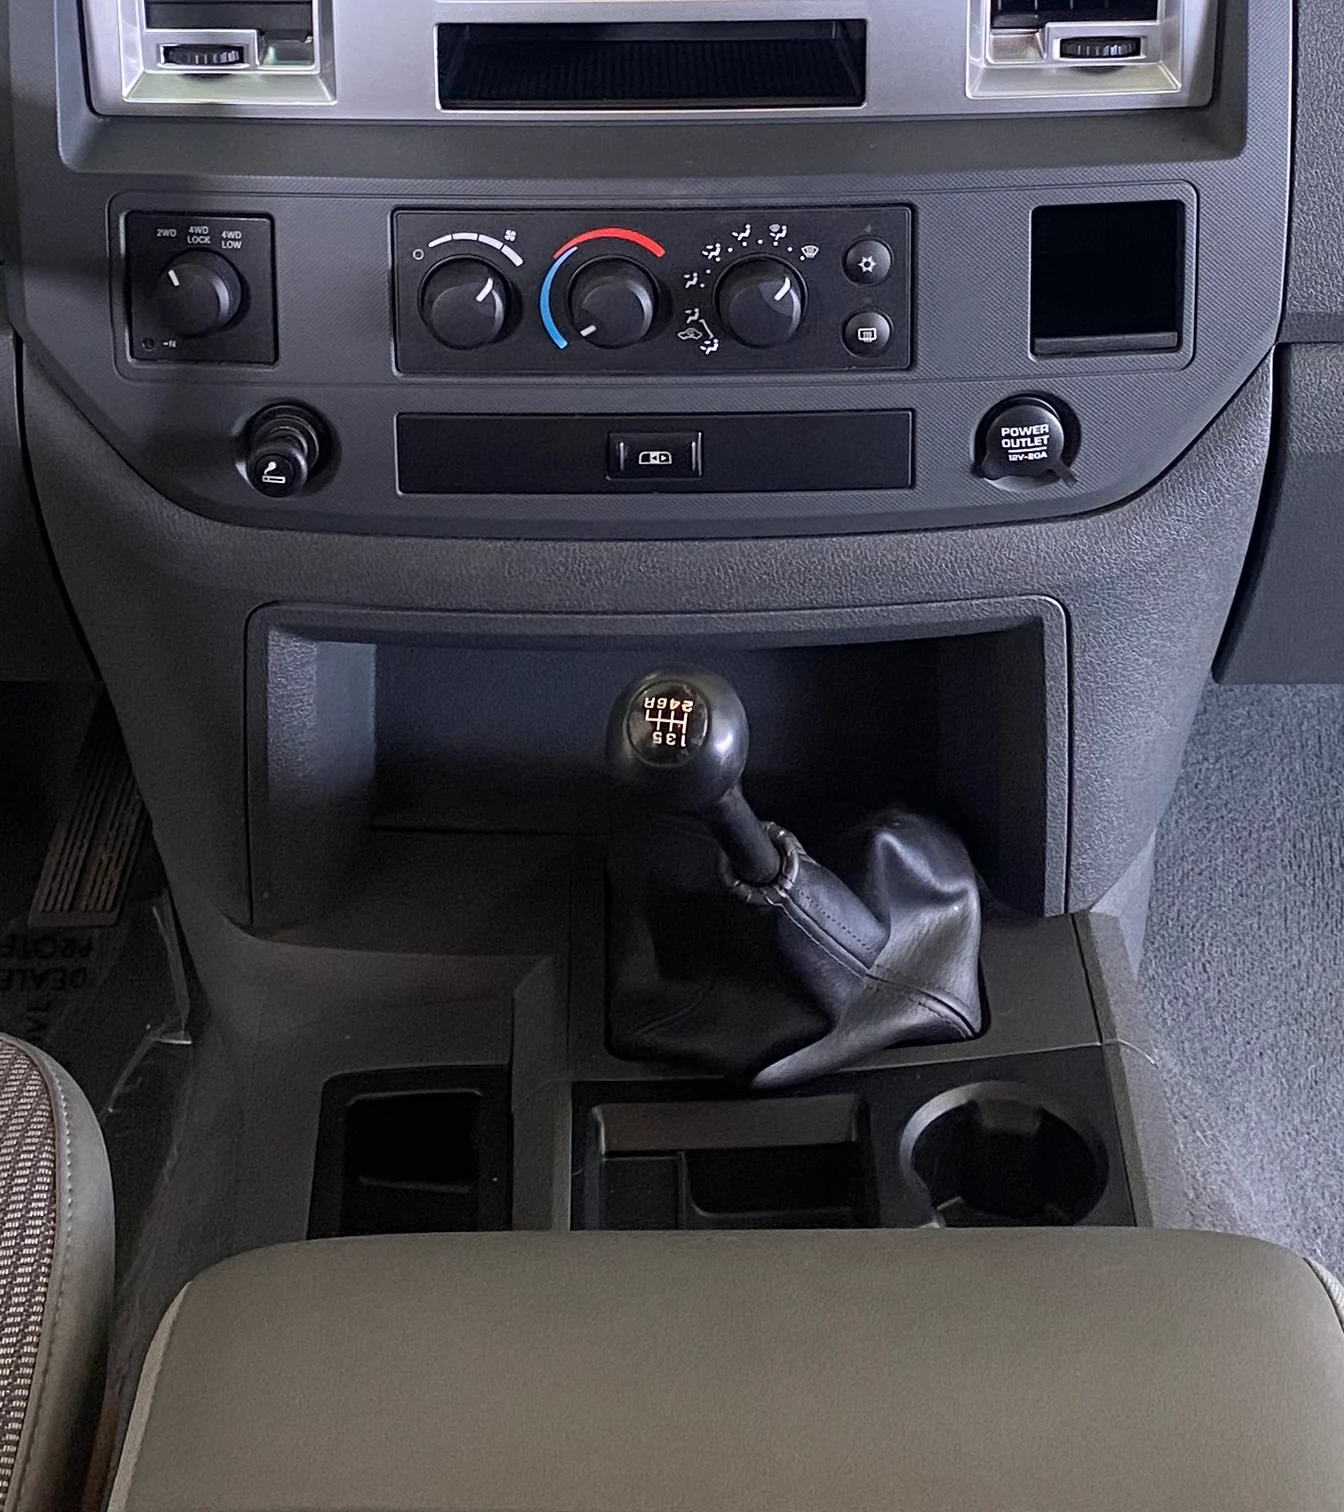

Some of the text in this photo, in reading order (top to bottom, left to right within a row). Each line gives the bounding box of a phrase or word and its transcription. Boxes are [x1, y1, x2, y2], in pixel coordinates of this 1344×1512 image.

[156, 229, 177, 237] 2WD
[188, 226, 209, 235] 4WD
[221, 230, 242, 239] 4WD
[187, 235, 211, 244] LOCK
[221, 240, 242, 249] LOW
[1000, 423, 1049, 437] POWER
[1001, 434, 1050, 448] OUTLET
[643, 696, 694, 713] 2 4 6 R
[652, 731, 687, 748] 1 3 5
